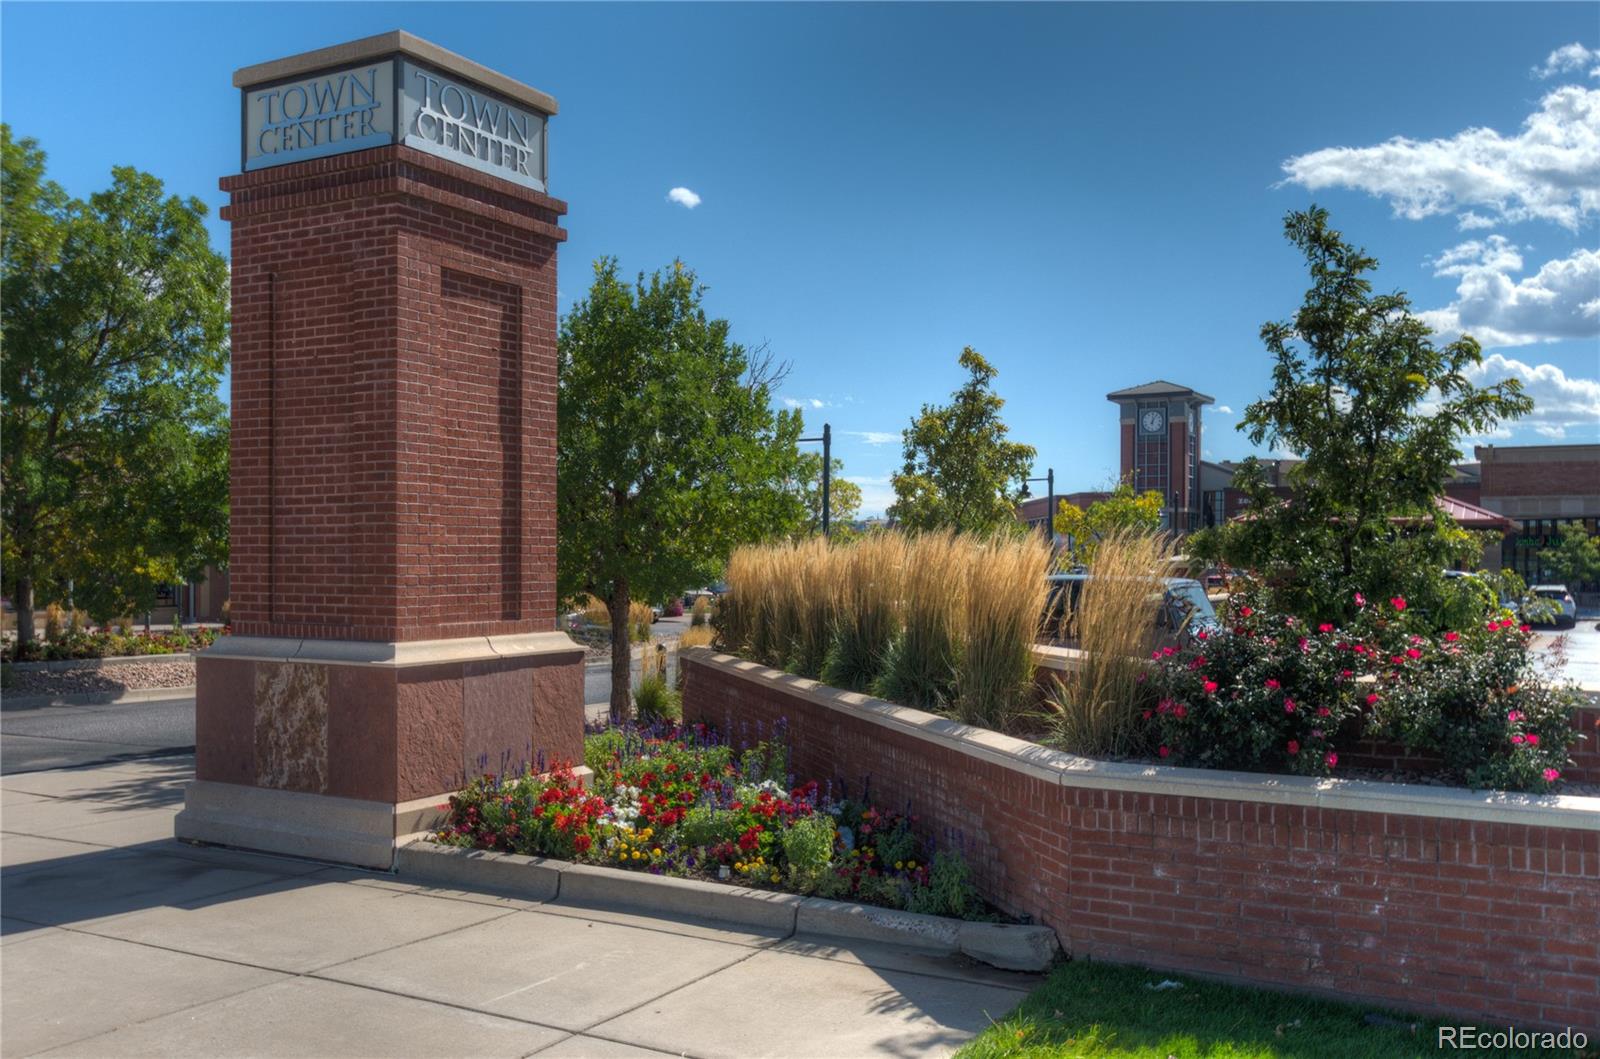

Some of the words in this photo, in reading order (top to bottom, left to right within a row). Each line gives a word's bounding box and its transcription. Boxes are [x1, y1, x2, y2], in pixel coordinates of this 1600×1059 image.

[257, 68, 378, 126] TOWN
[415, 71, 530, 149] TOWN
[257, 108, 378, 155] CENTER
[417, 112, 531, 177] CENTER
